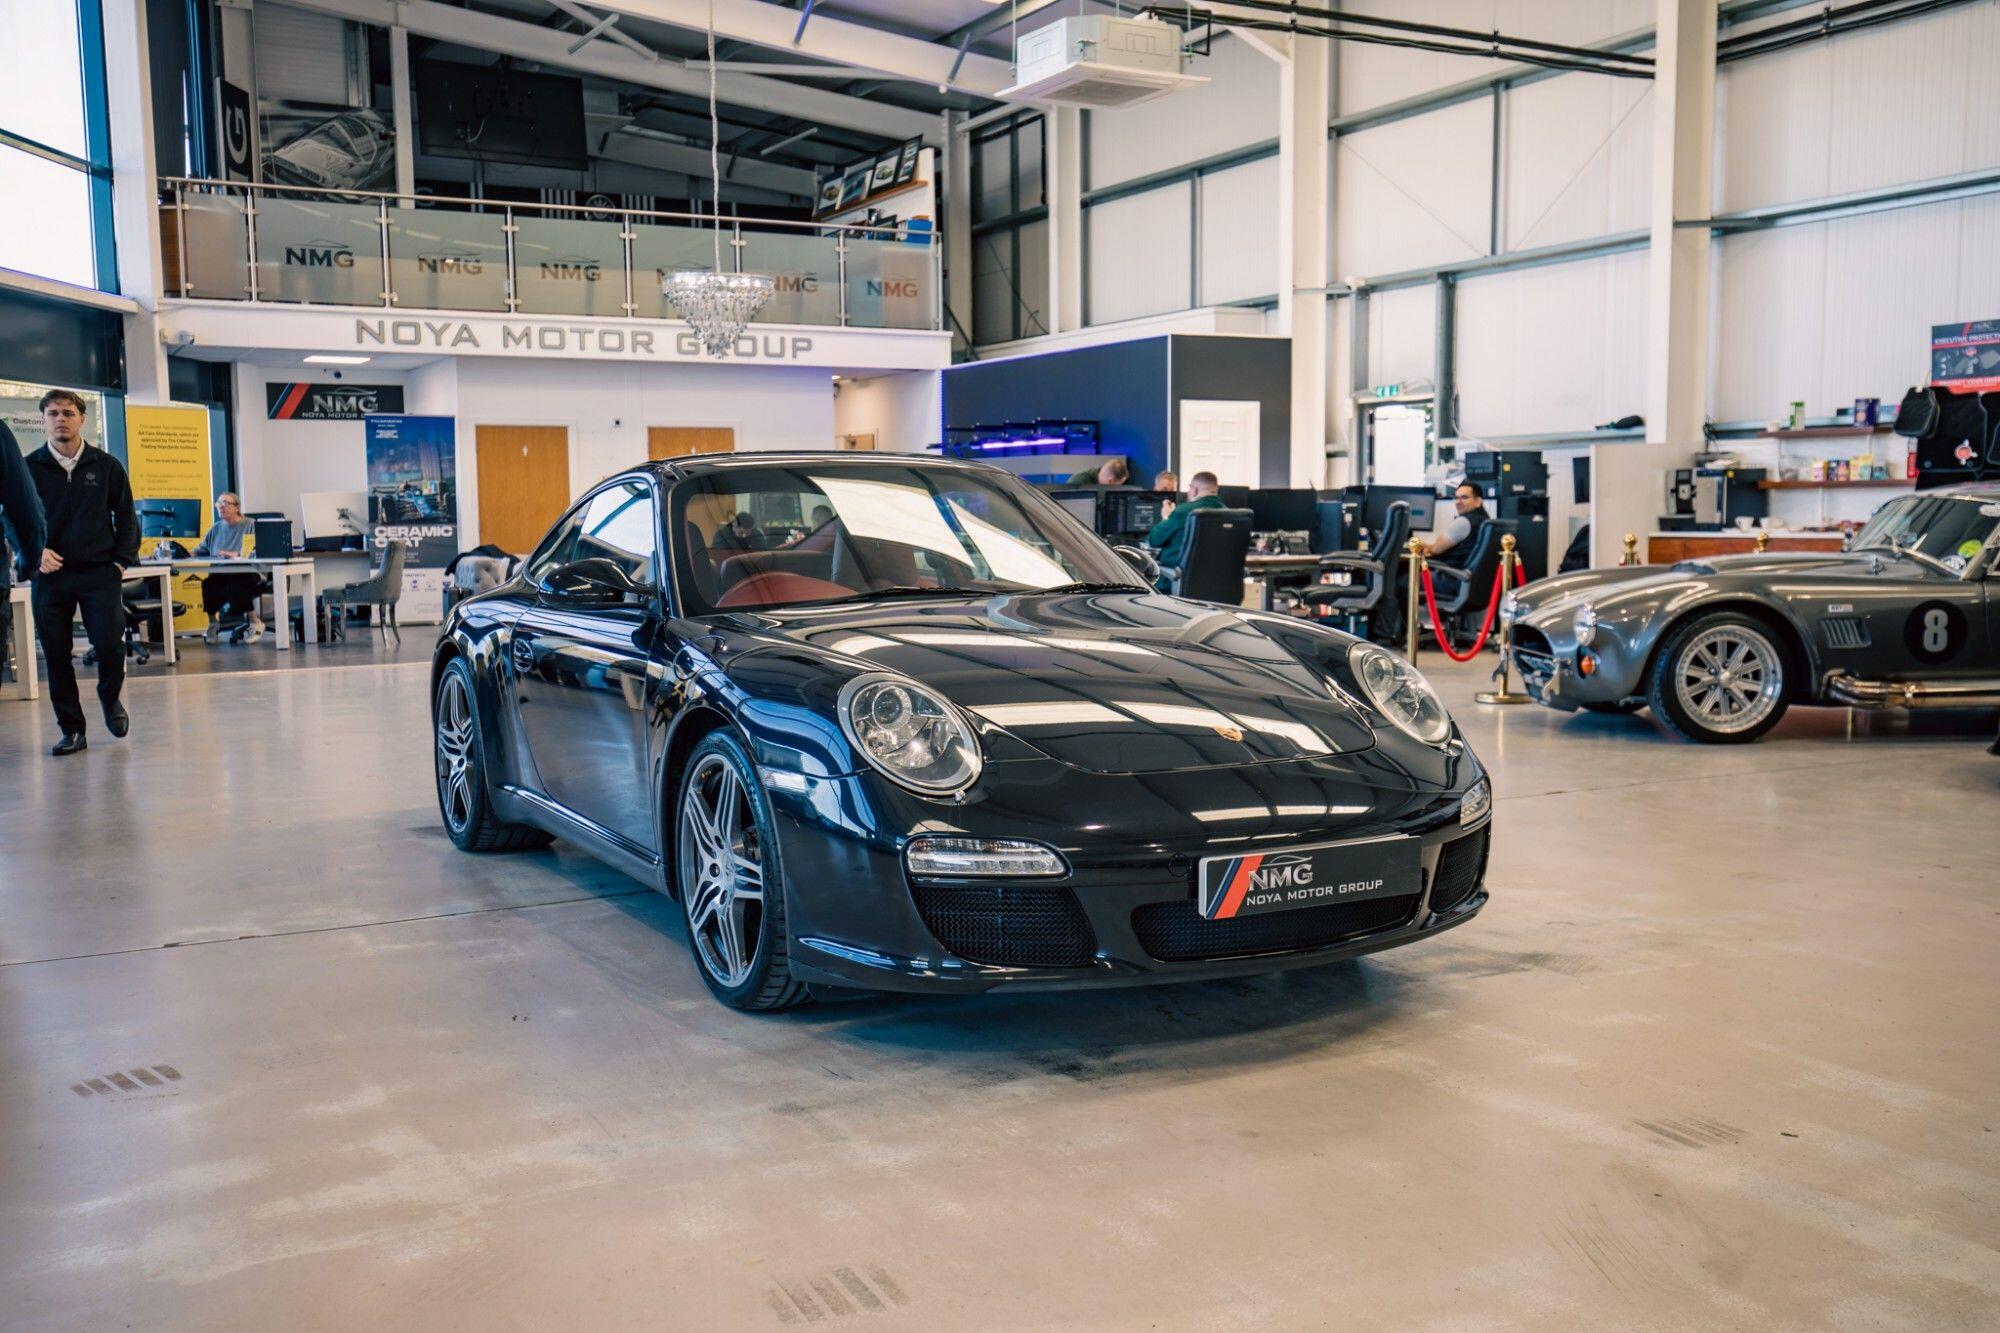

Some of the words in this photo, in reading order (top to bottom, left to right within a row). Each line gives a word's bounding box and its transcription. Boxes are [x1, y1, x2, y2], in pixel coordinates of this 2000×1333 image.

[285, 246, 354, 268] NMG
[418, 255, 482, 275] NMG
[540, 262, 601, 281] NMG
[866, 280, 918, 298] NMG
[355, 319, 480, 348] NOYA
[502, 324, 655, 354] MOTOR
[676, 332, 813, 359] GOUP
[313, 395, 379, 413] NMG
[374, 526, 453, 538] CERAMIC
[1923, 608, 1949, 653] 8
[1247, 863, 1314, 892] NMG
[1246, 893, 1282, 906] NOYA
[1287, 886, 1333, 901] MOTOR
[1339, 879, 1384, 895] GROUP
